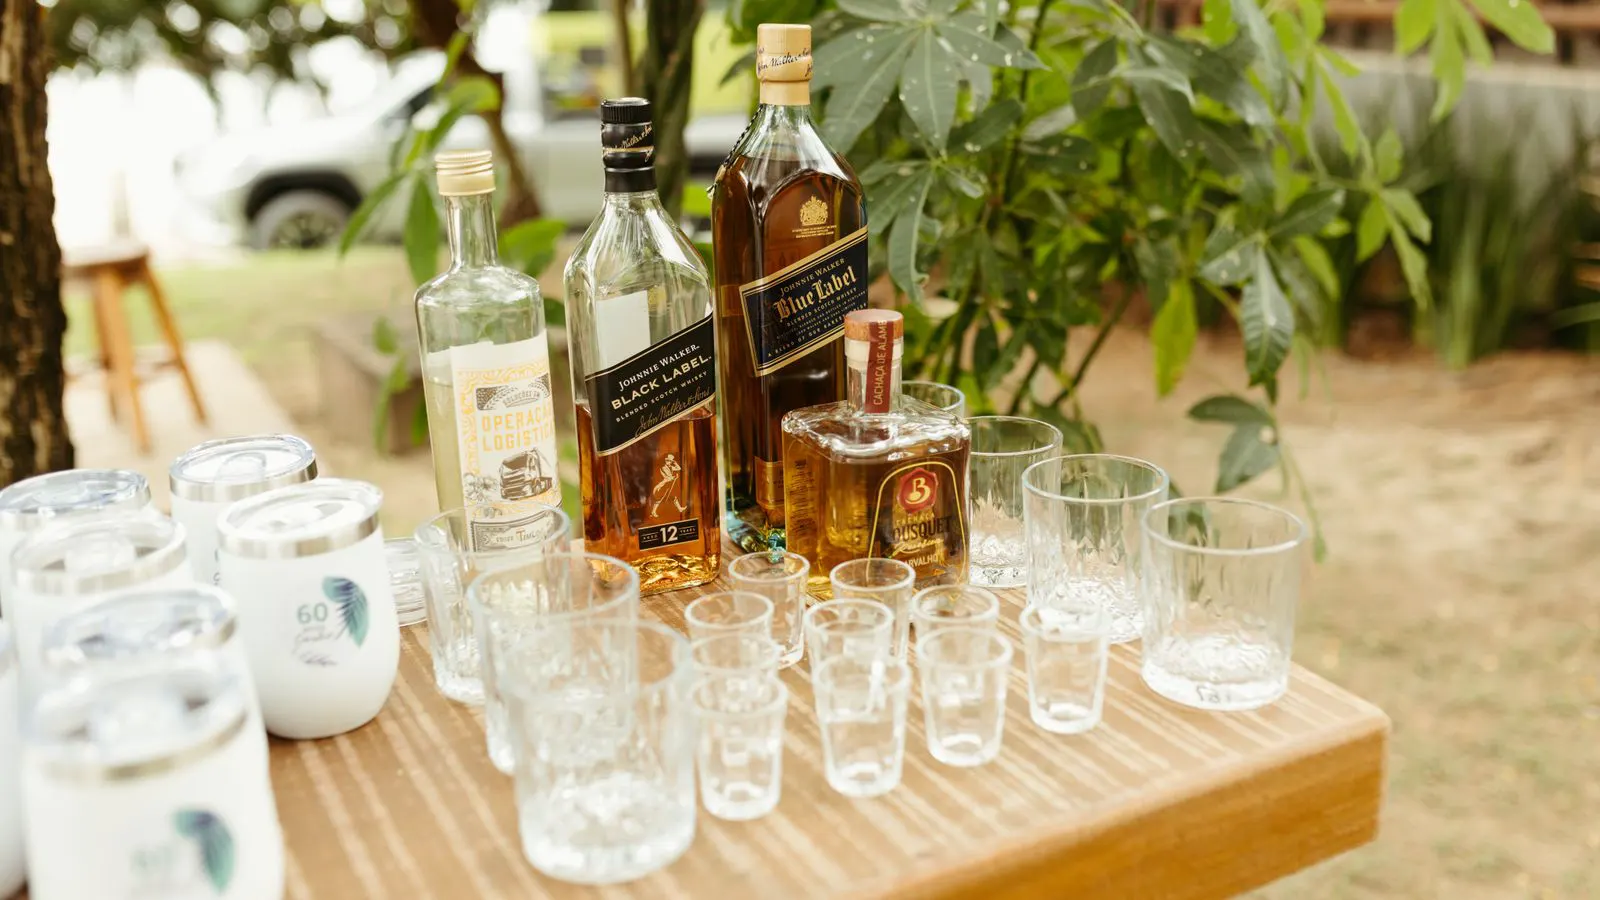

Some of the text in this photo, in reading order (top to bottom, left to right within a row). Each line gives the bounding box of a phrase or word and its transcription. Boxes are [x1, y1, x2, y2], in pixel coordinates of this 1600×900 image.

[773, 265, 857, 323] Blue Label
[780, 258, 845, 297] JOHNNIE WALKER
[618, 363, 660, 392] JOHNNIE
[876, 352, 887, 364] DE
[611, 355, 709, 410] BLACK LABEL
[615, 370, 707, 423] BLENDED SCOTCH WHISKY
[873, 364, 887, 406] CACHAÇA
[659, 525, 678, 543] 12
[296, 602, 329, 624] 60
